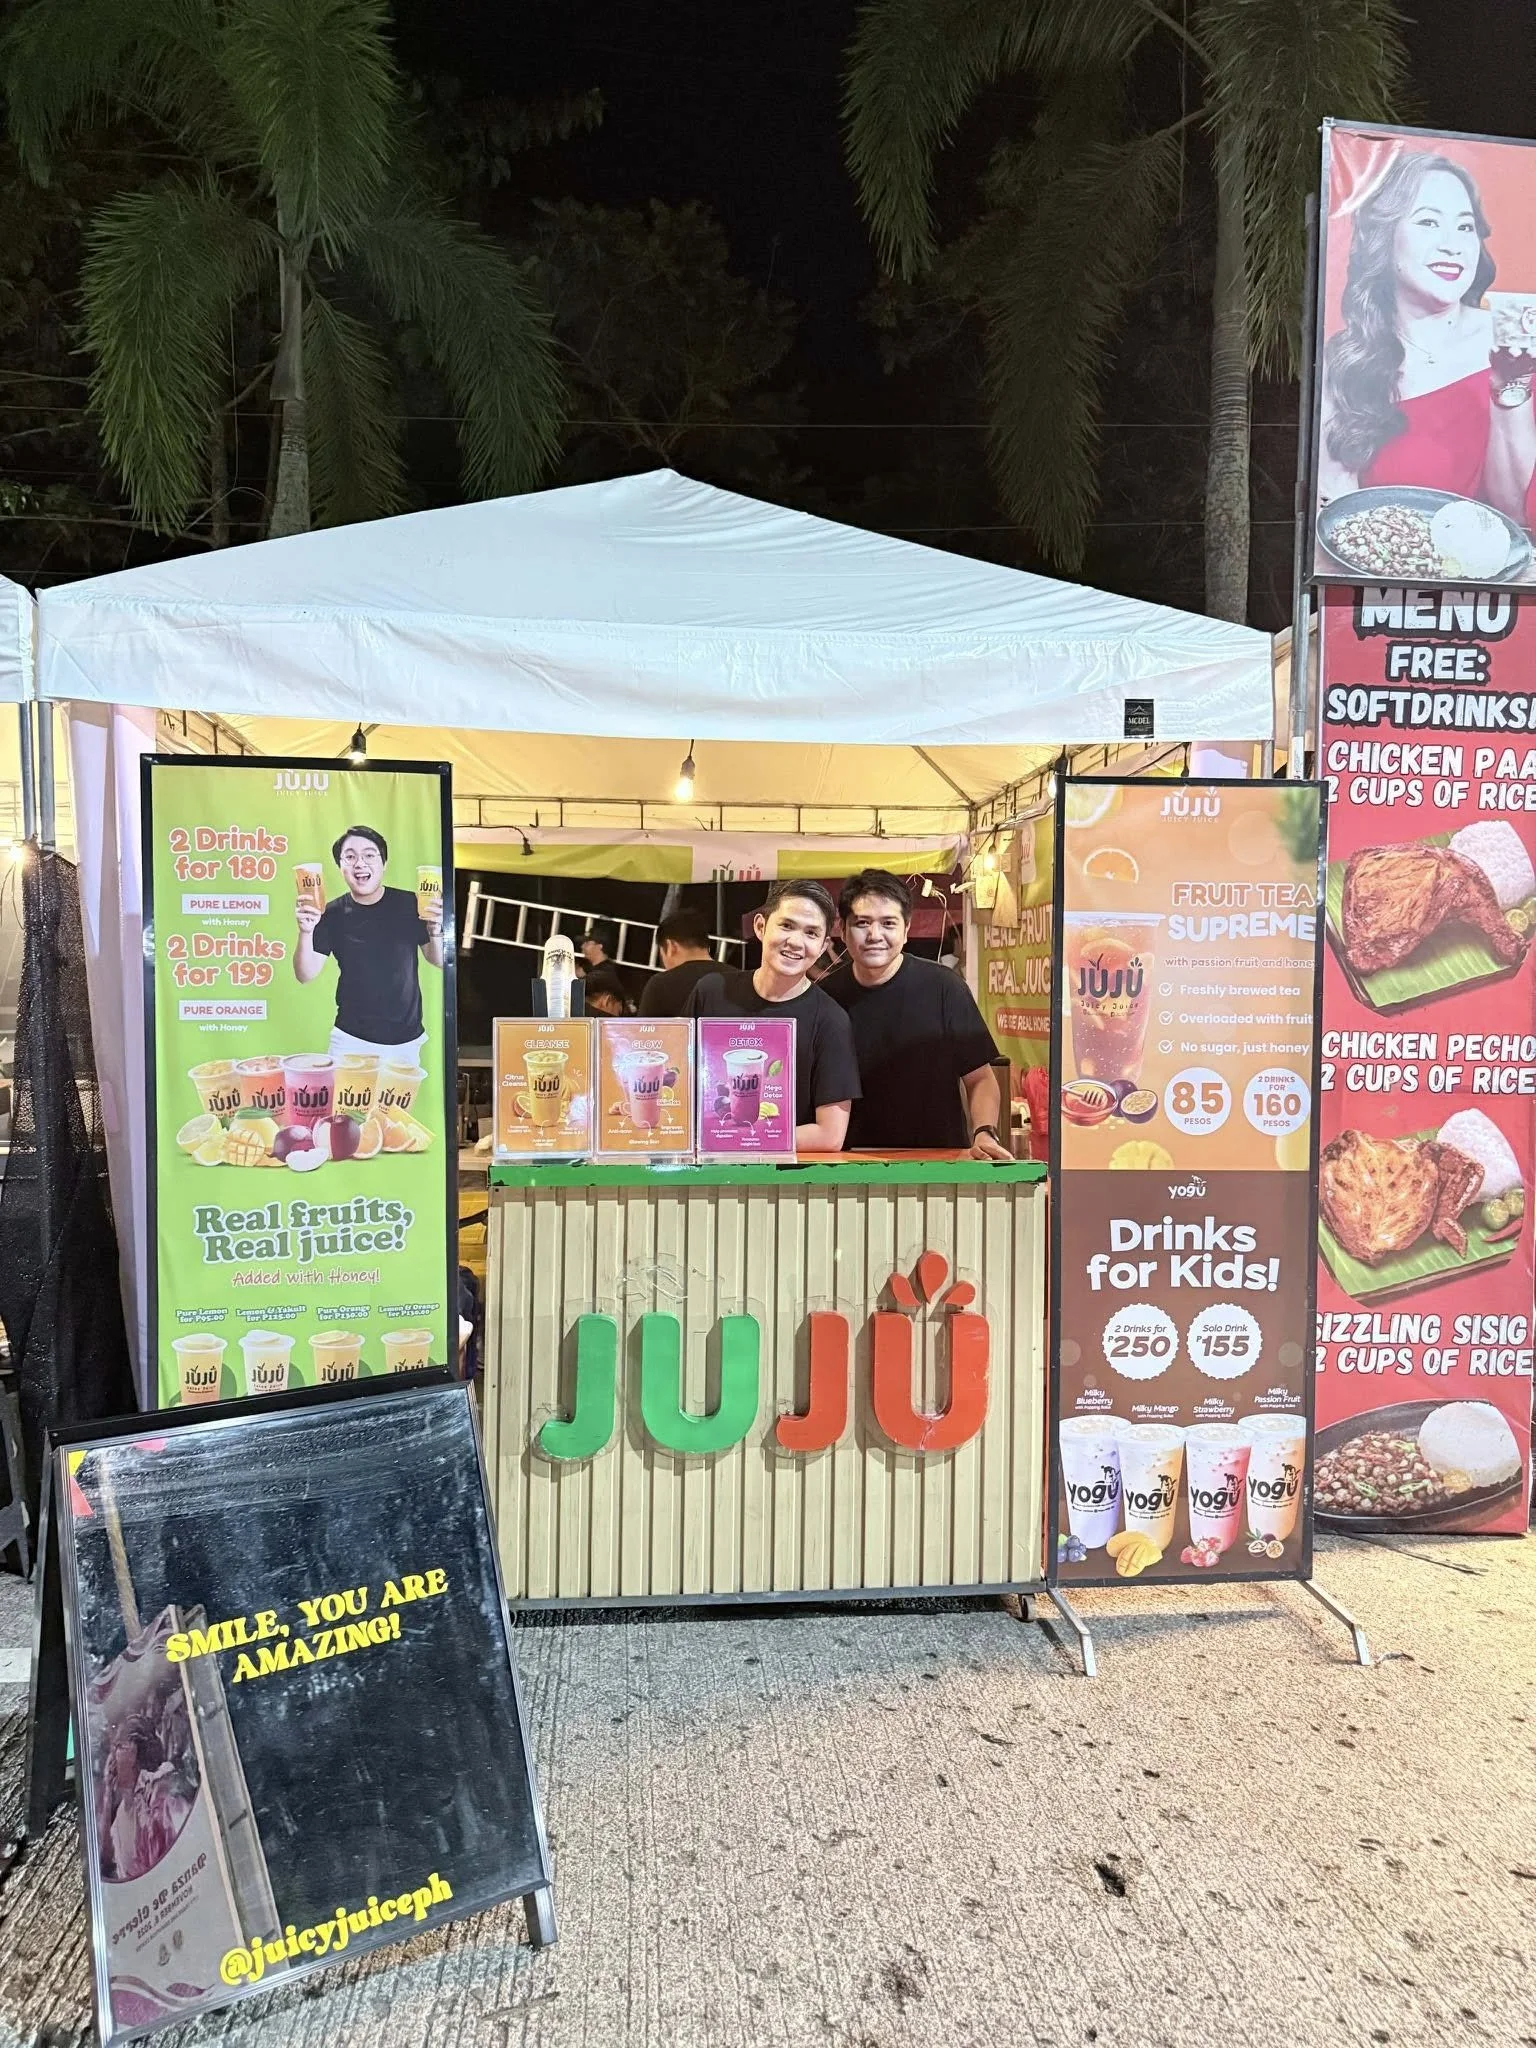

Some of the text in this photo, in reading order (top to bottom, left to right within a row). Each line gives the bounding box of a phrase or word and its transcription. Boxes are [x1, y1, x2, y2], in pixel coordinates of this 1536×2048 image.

[1361, 586, 1511, 634] MENU
[1390, 645, 1487, 681] FREE:
[1327, 740, 1463, 777] CHICKEN
[1160, 785, 1220, 817] JUJU
[1349, 776, 1424, 808] CUPS
[1433, 779, 1470, 809] OF
[1478, 782, 1536, 811] RICE
[170, 826, 288, 854] 2 Drinks
[175, 856, 276, 881] for 180
[190, 900, 262, 910] PURE LEMON
[1172, 882, 1316, 907] FRUIT TEA
[201, 917, 251, 928] with Honey
[1167, 911, 1316, 942] SUPREME
[167, 932, 285, 961] 2 Drinks
[174, 962, 274, 988] for 199
[1165, 957, 1282, 968] with passion fruit and
[1078, 953, 1143, 998] JUJU
[1179, 984, 1300, 998] Freshly brewed tea
[184, 1006, 263, 1015] PURE ORANGE
[1179, 1013, 1253, 1024] Overloaded
[1256, 1013, 1284, 1024] with
[199, 1023, 248, 1034] with Honey
[525, 1040, 569, 1048] CLEANSE
[631, 1040, 663, 1049] GLOW
[729, 1038, 763, 1047] DETOX
[1180, 1042, 1310, 1056] No sugar, just honey
[1321, 1030, 1536, 1062] CHICKEN PECHO
[1321, 1063, 1536, 1094] 2 CUPS OF RICE
[1172, 1081, 1224, 1115] 85
[1253, 1094, 1301, 1116] 160
[195, 1196, 414, 1234] Real fruits,
[204, 1224, 406, 1264] Real juice!
[1109, 1215, 1257, 1252] Drinks
[232, 1267, 380, 1286] Added with Honey!
[1086, 1253, 1280, 1292] for Kids!
[1114, 1324, 1167, 1334] 2 Drinks for
[1203, 1323, 1248, 1333] Solo Drink
[1452, 1314, 1528, 1346] SISIG
[1337, 1347, 1414, 1375] CUPS
[1422, 1348, 1460, 1375] OF
[1469, 1349, 1534, 1376] RICE
[1076, 1397, 1113, 1406] Blueberry
[1084, 1389, 1105, 1398] Milky
[1203, 1398, 1224, 1406] Milky
[1254, 1395, 1301, 1403] Passion Fruit
[1267, 1388, 1288, 1396] Milky
[1132, 1405, 1179, 1413] Milky Mango
[1193, 1406, 1235, 1414] Strawberry
[165, 1568, 448, 1662] SMILE, YOU ARE
[232, 1613, 402, 1683] AMAZING!
[219, 1872, 454, 1986] @juicyjuiceph
